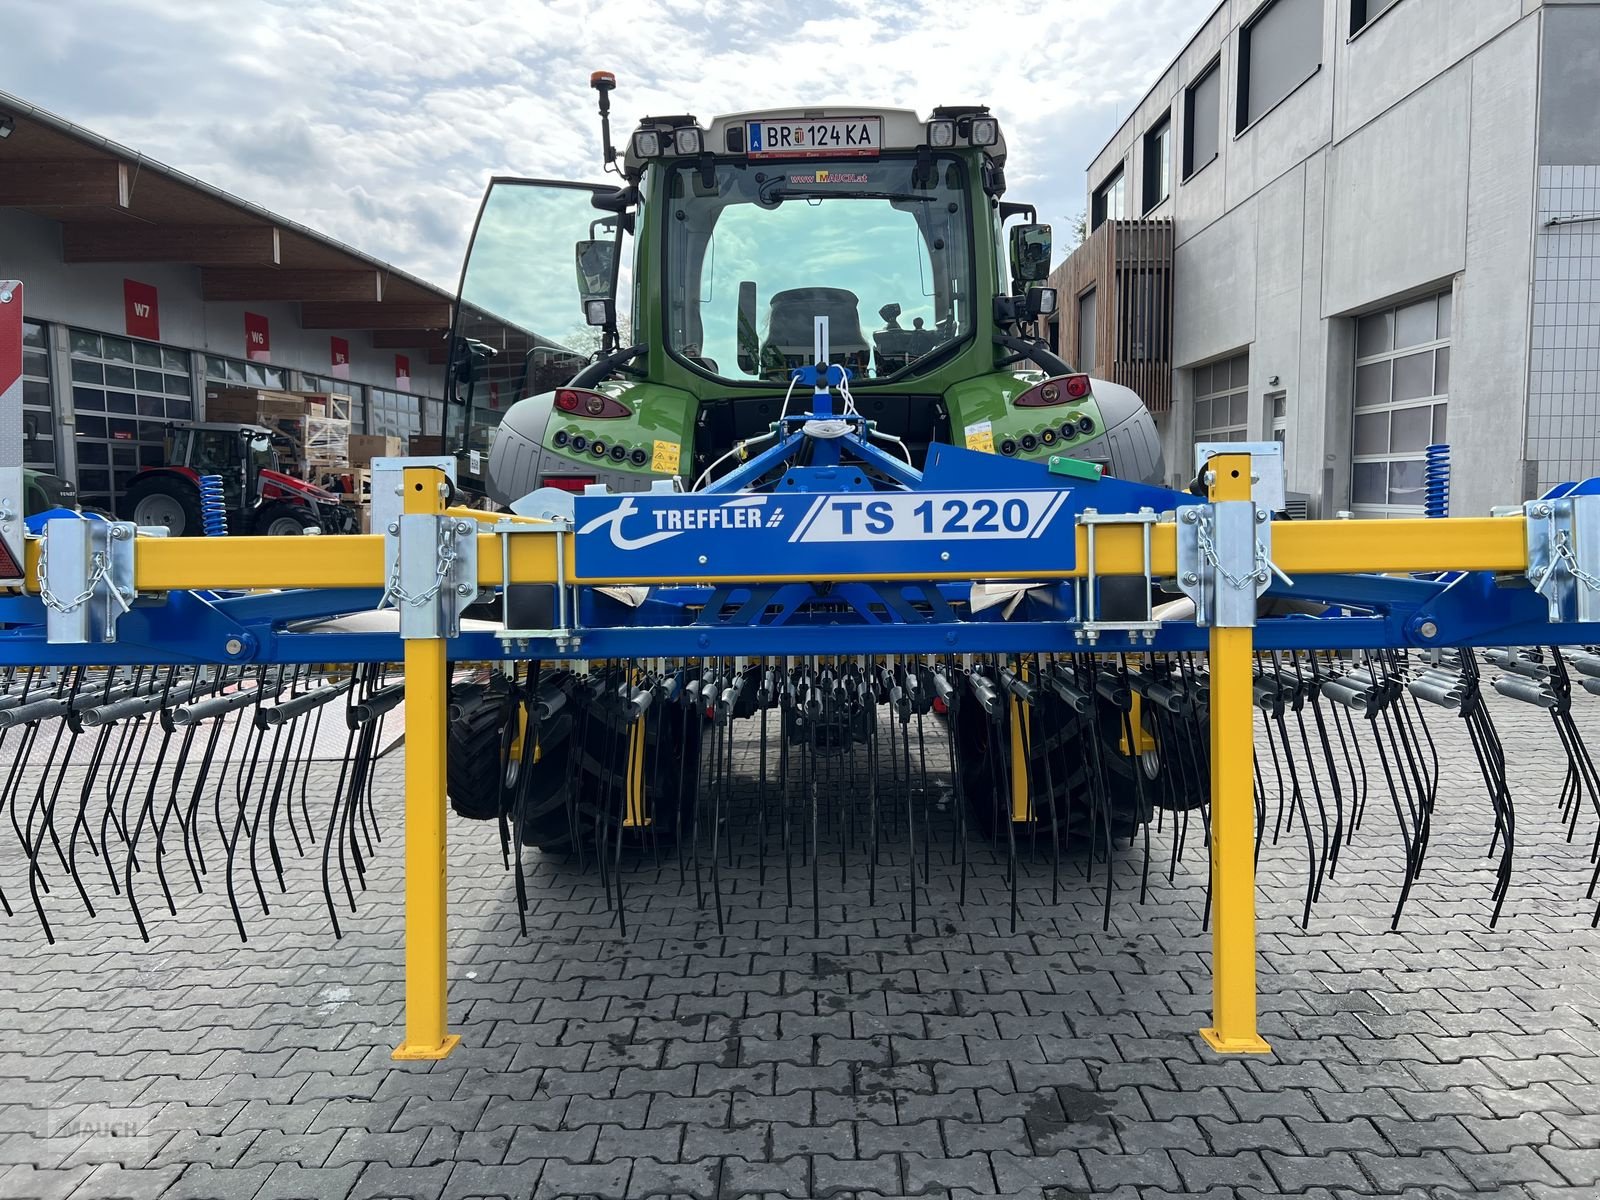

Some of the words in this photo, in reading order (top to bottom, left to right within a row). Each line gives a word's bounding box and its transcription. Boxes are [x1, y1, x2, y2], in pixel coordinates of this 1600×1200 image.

[752, 140, 760, 148] A
[767, 126, 792, 147] BR
[807, 125, 841, 146] 124
[846, 123, 871, 145] KA
[134, 302, 150, 318] W7
[251, 331, 264, 345] W6
[652, 508, 762, 530] TREFFLER
[831, 501, 895, 535] TS
[913, 498, 1030, 534] 1220
